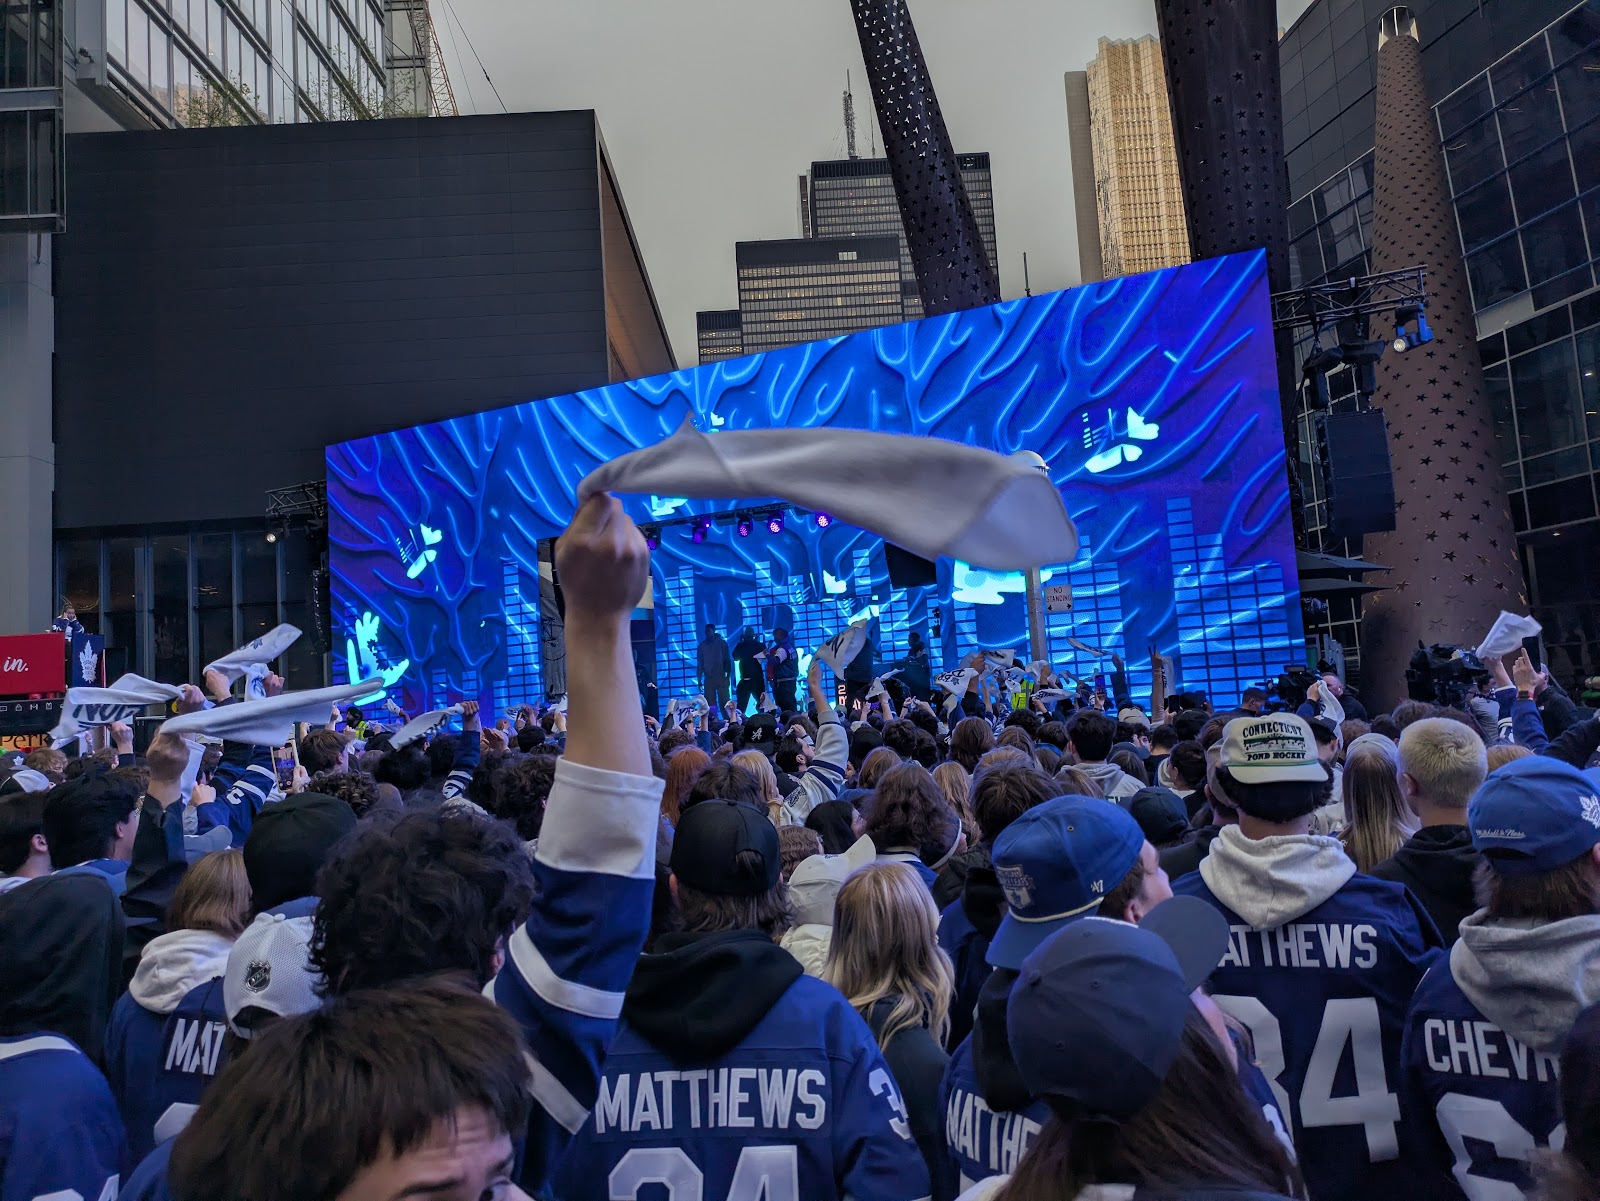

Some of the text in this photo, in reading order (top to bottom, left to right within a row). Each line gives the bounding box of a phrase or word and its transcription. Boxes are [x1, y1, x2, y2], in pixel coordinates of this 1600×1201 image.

[1053, 586, 1063, 594] NO
[1046, 594, 1072, 603] STANDING
[3, 656, 29, 672] in.
[1242, 721, 1303, 739] CONNECTICUT
[1246, 751, 1306, 762] POND HOCKEY
[1217, 923, 1378, 969] ATTHEWS
[595, 1067, 826, 1134] MATTHEWS
